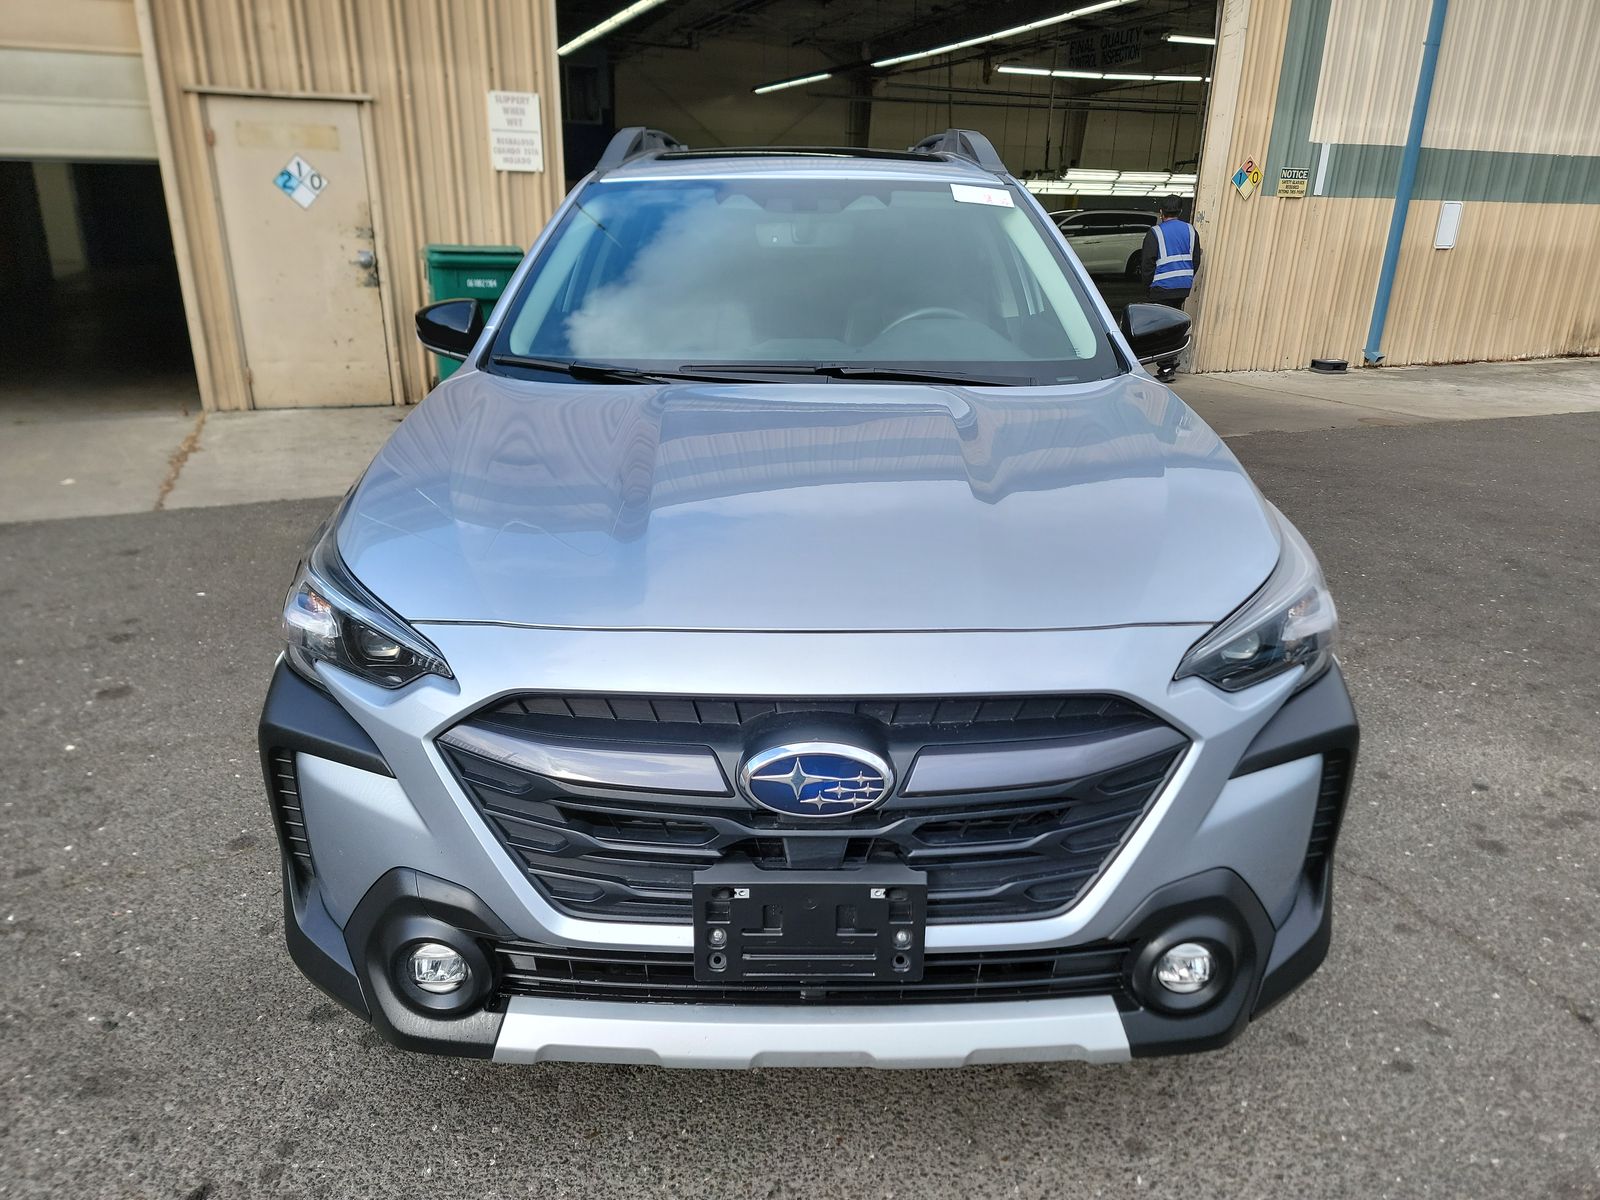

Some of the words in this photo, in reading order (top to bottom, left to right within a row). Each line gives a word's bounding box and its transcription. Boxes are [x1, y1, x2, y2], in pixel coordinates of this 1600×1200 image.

[1069, 38, 1096, 55] FINAL
[1101, 26, 1143, 49] QUALITY
[494, 95, 529, 105] SLIPPERY
[502, 107, 526, 116] WHEN
[505, 118, 523, 127] WET
[296, 161, 302, 177] 1
[1245, 160, 1253, 173] 2
[280, 170, 295, 191] 2
[1238, 172, 1243, 185] 1
[1252, 171, 1259, 184] 0
[1281, 170, 1309, 179] NOTICE
[310, 174, 322, 190] 0
